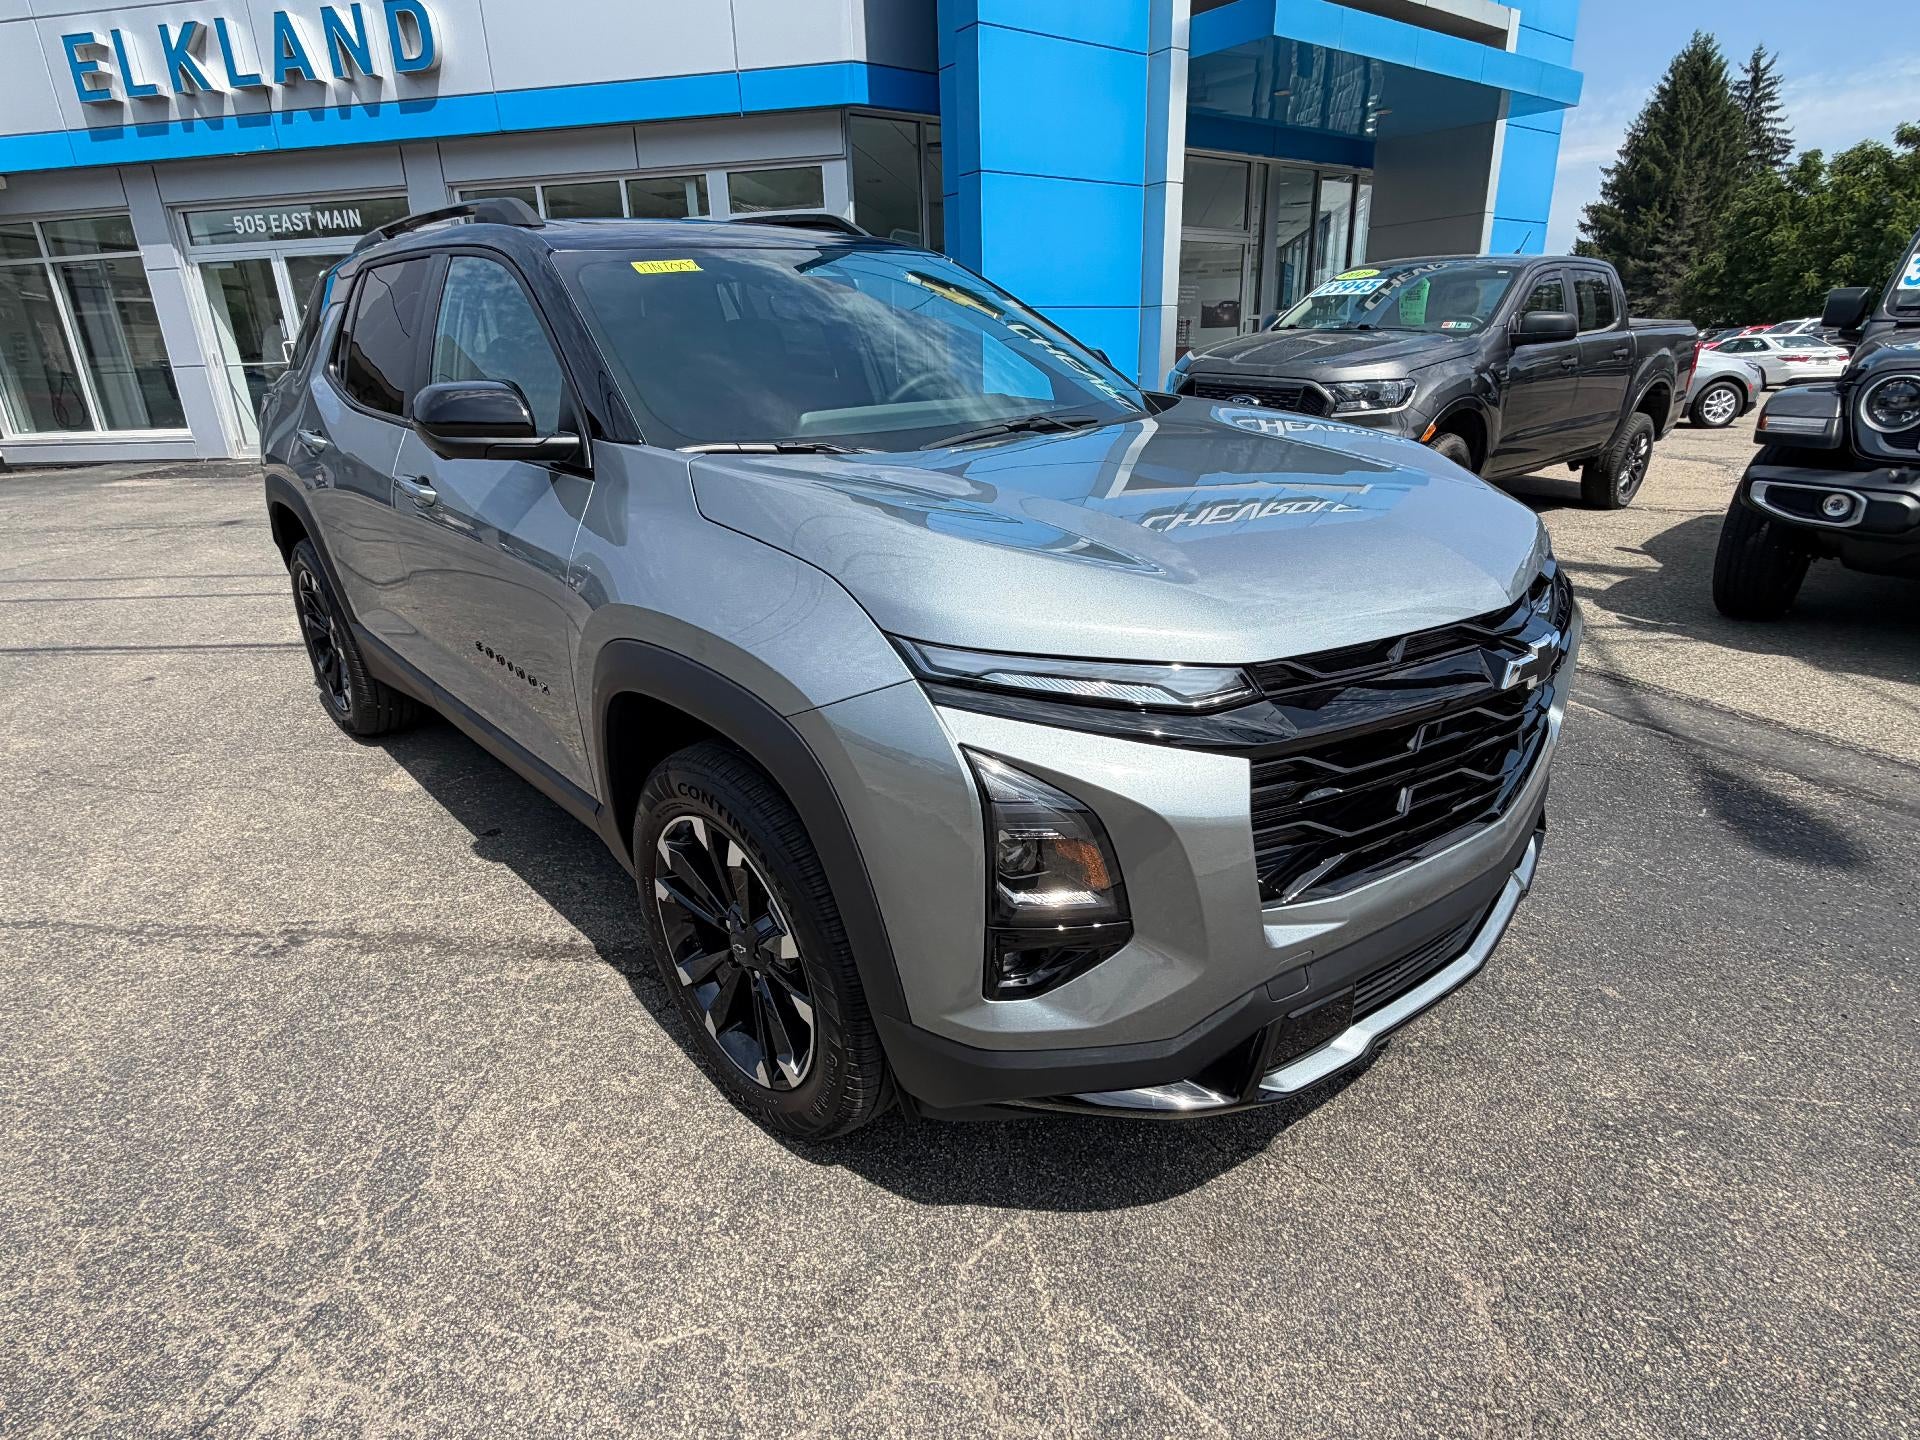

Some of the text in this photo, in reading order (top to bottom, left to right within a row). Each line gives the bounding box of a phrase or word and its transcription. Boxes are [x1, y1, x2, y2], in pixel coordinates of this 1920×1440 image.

[62, 0, 441, 104] ELKLAND
[233, 208, 362, 235] 505 EAST MAIN
[1314, 280, 1383, 295] 23995
